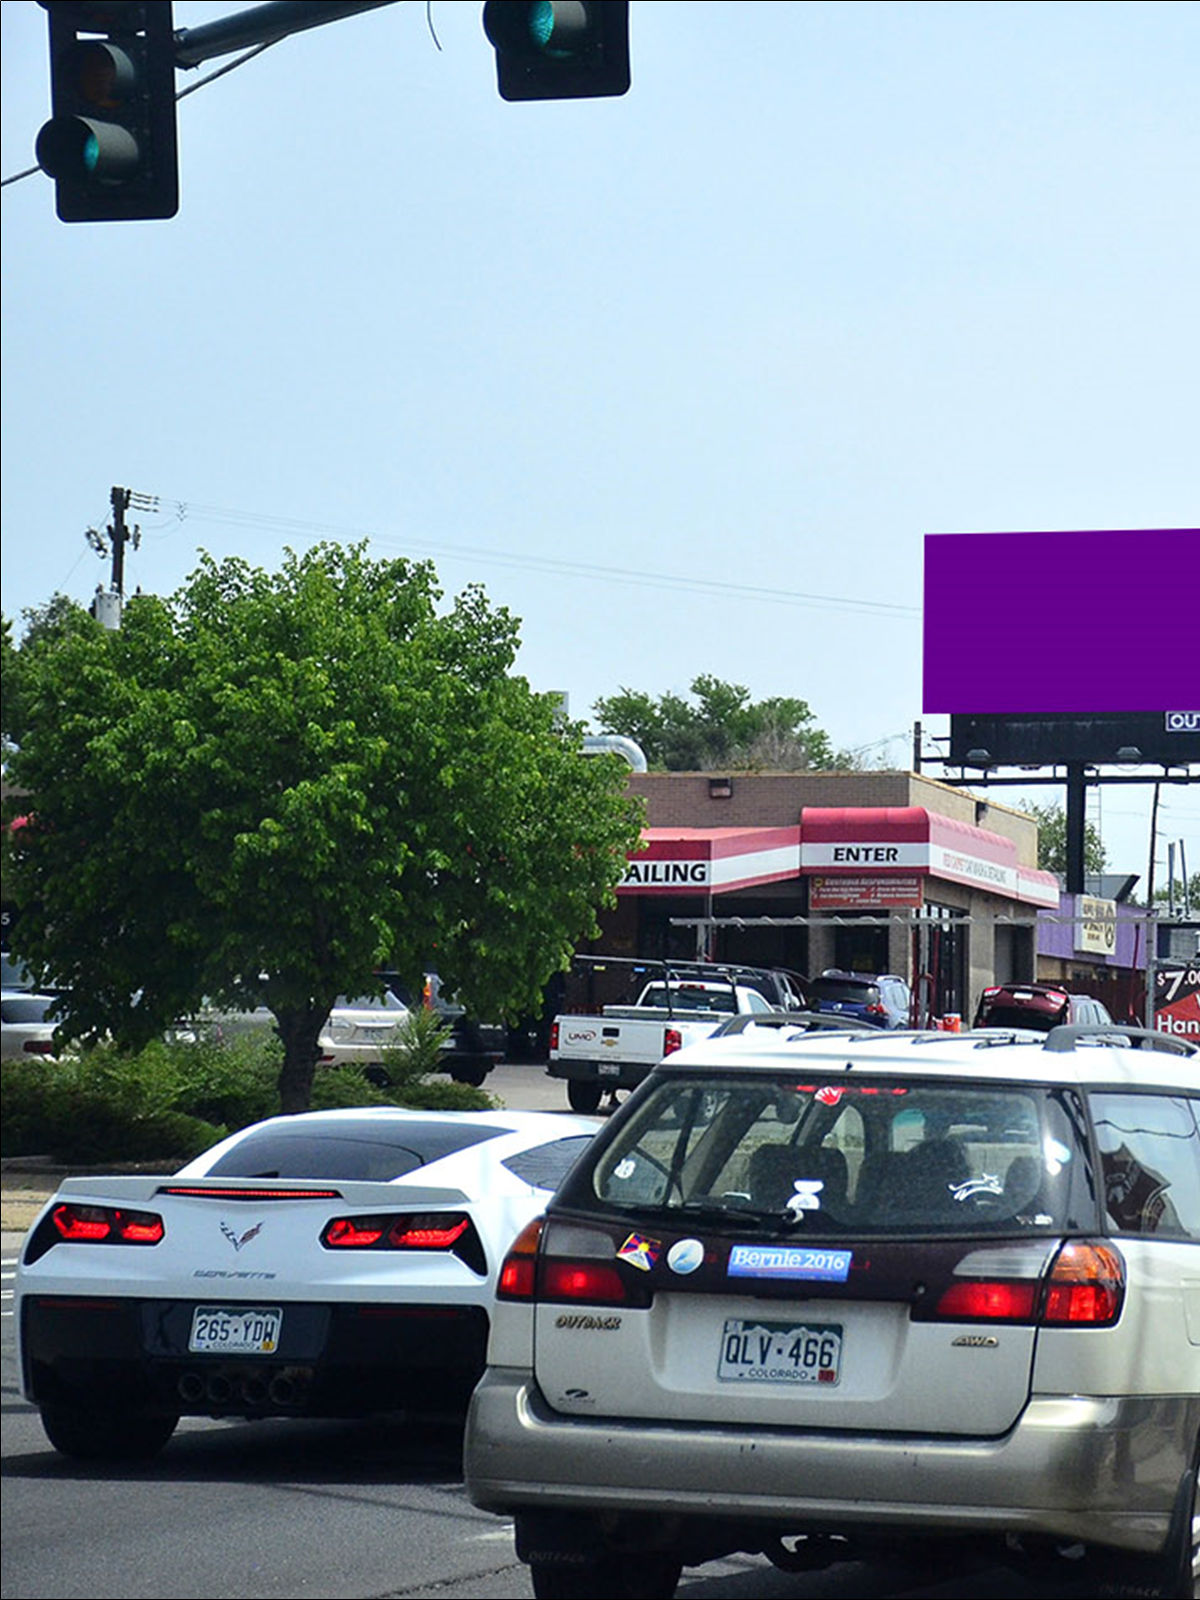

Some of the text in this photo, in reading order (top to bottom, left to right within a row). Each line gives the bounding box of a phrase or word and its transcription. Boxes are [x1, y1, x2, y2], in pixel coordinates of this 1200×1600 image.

[833, 847, 899, 862] ENTER
[624, 863, 706, 882] AILING
[733, 1250, 845, 1270] Bernie 2016
[555, 1315, 622, 1331] OUTBACK
[951, 1336, 999, 1348] AWD
[748, 1367, 808, 1380] COLORADO
